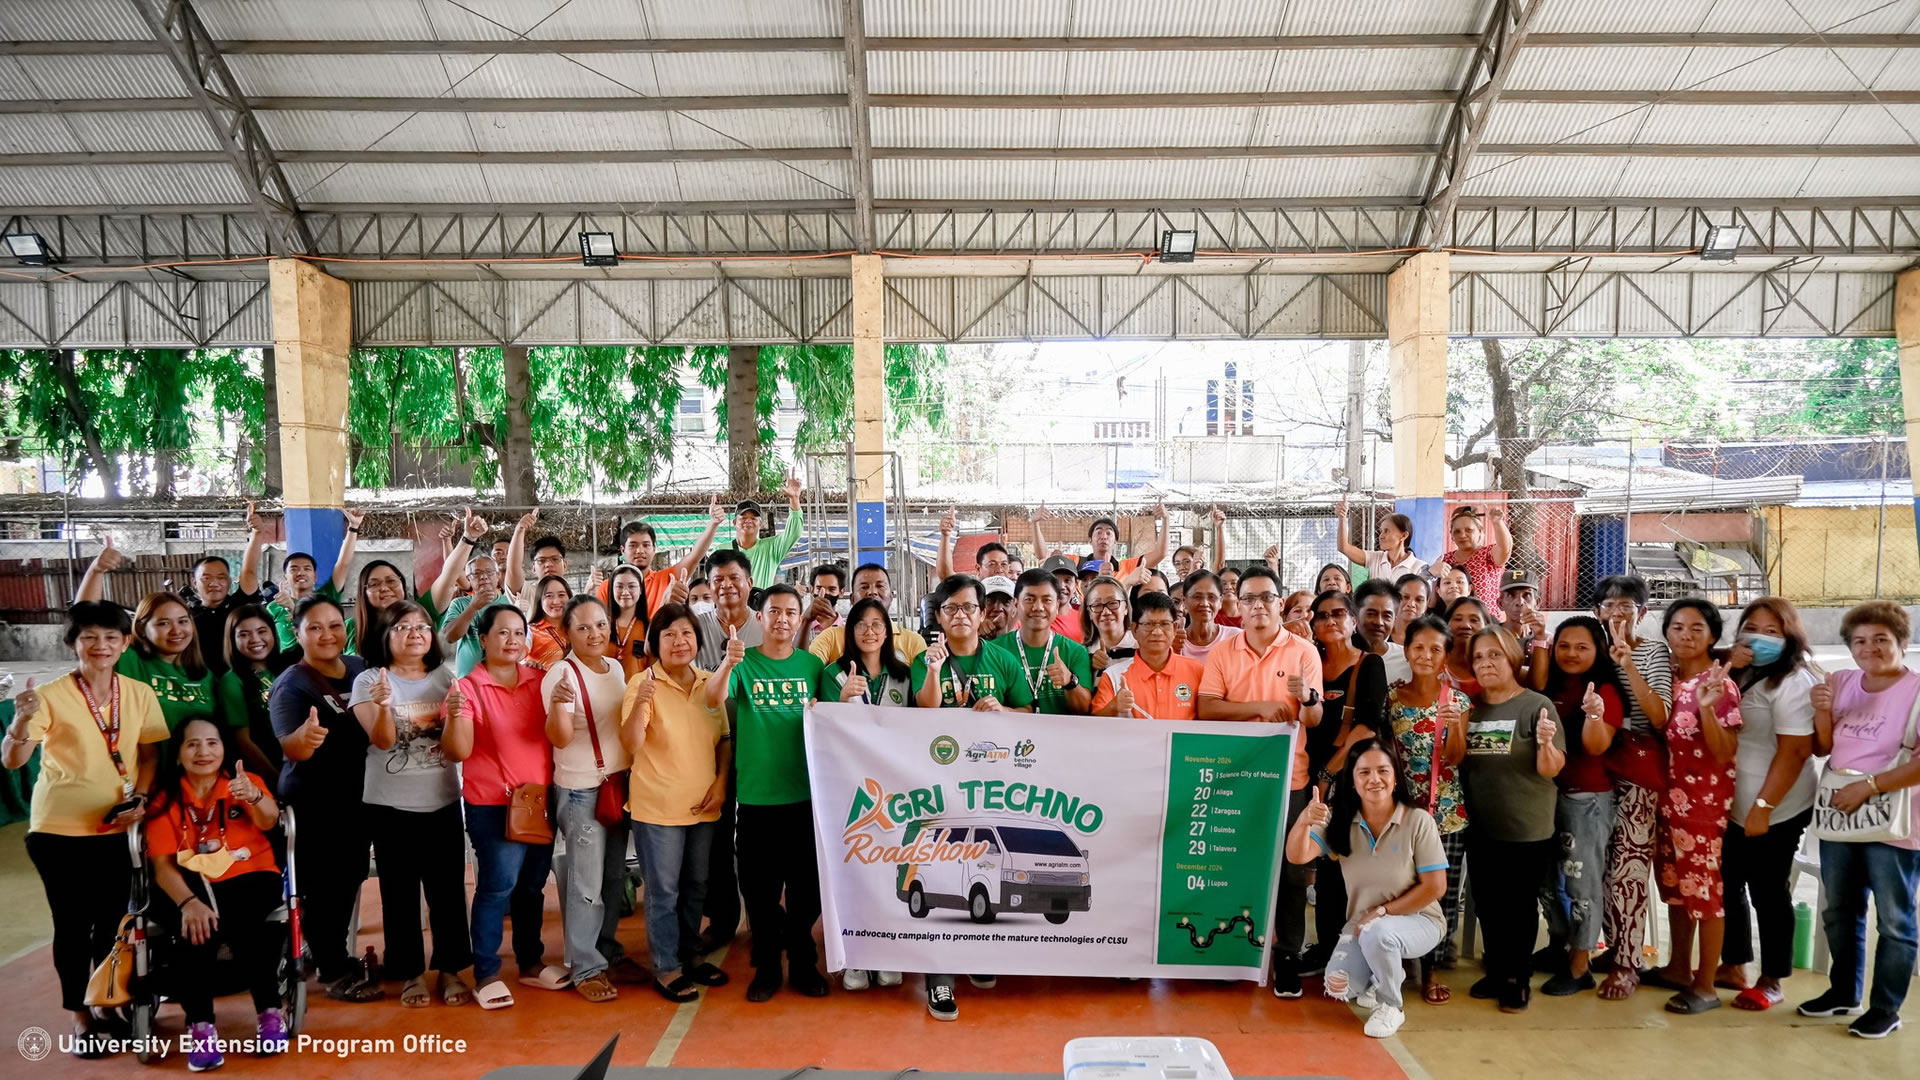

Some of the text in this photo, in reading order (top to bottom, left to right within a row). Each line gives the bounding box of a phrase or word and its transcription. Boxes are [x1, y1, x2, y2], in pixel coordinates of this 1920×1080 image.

[965, 750, 1009, 760] AgriATM
[1184, 756, 1216, 764] November
[1199, 768, 1214, 783] 15
[1240, 770, 1252, 779] City
[1193, 787, 1233, 801] 20 Aliaga
[842, 777, 1104, 838] AGRI TECHNO
[1190, 804, 1241, 818] 22 Zaragoza
[1815, 804, 1891, 831] WOMAN
[1189, 821, 1236, 836] 27 Guimba
[843, 829, 989, 865] Roadshow
[1188, 840, 1237, 856] 29 Talavera
[1034, 861, 1081, 869] www.agriatm.com
[1176, 863, 1207, 871] December
[1187, 875, 1228, 891] 04 Lupao
[842, 928, 1128, 945] An advocacy campaign to promote the mature technologies of CLSU
